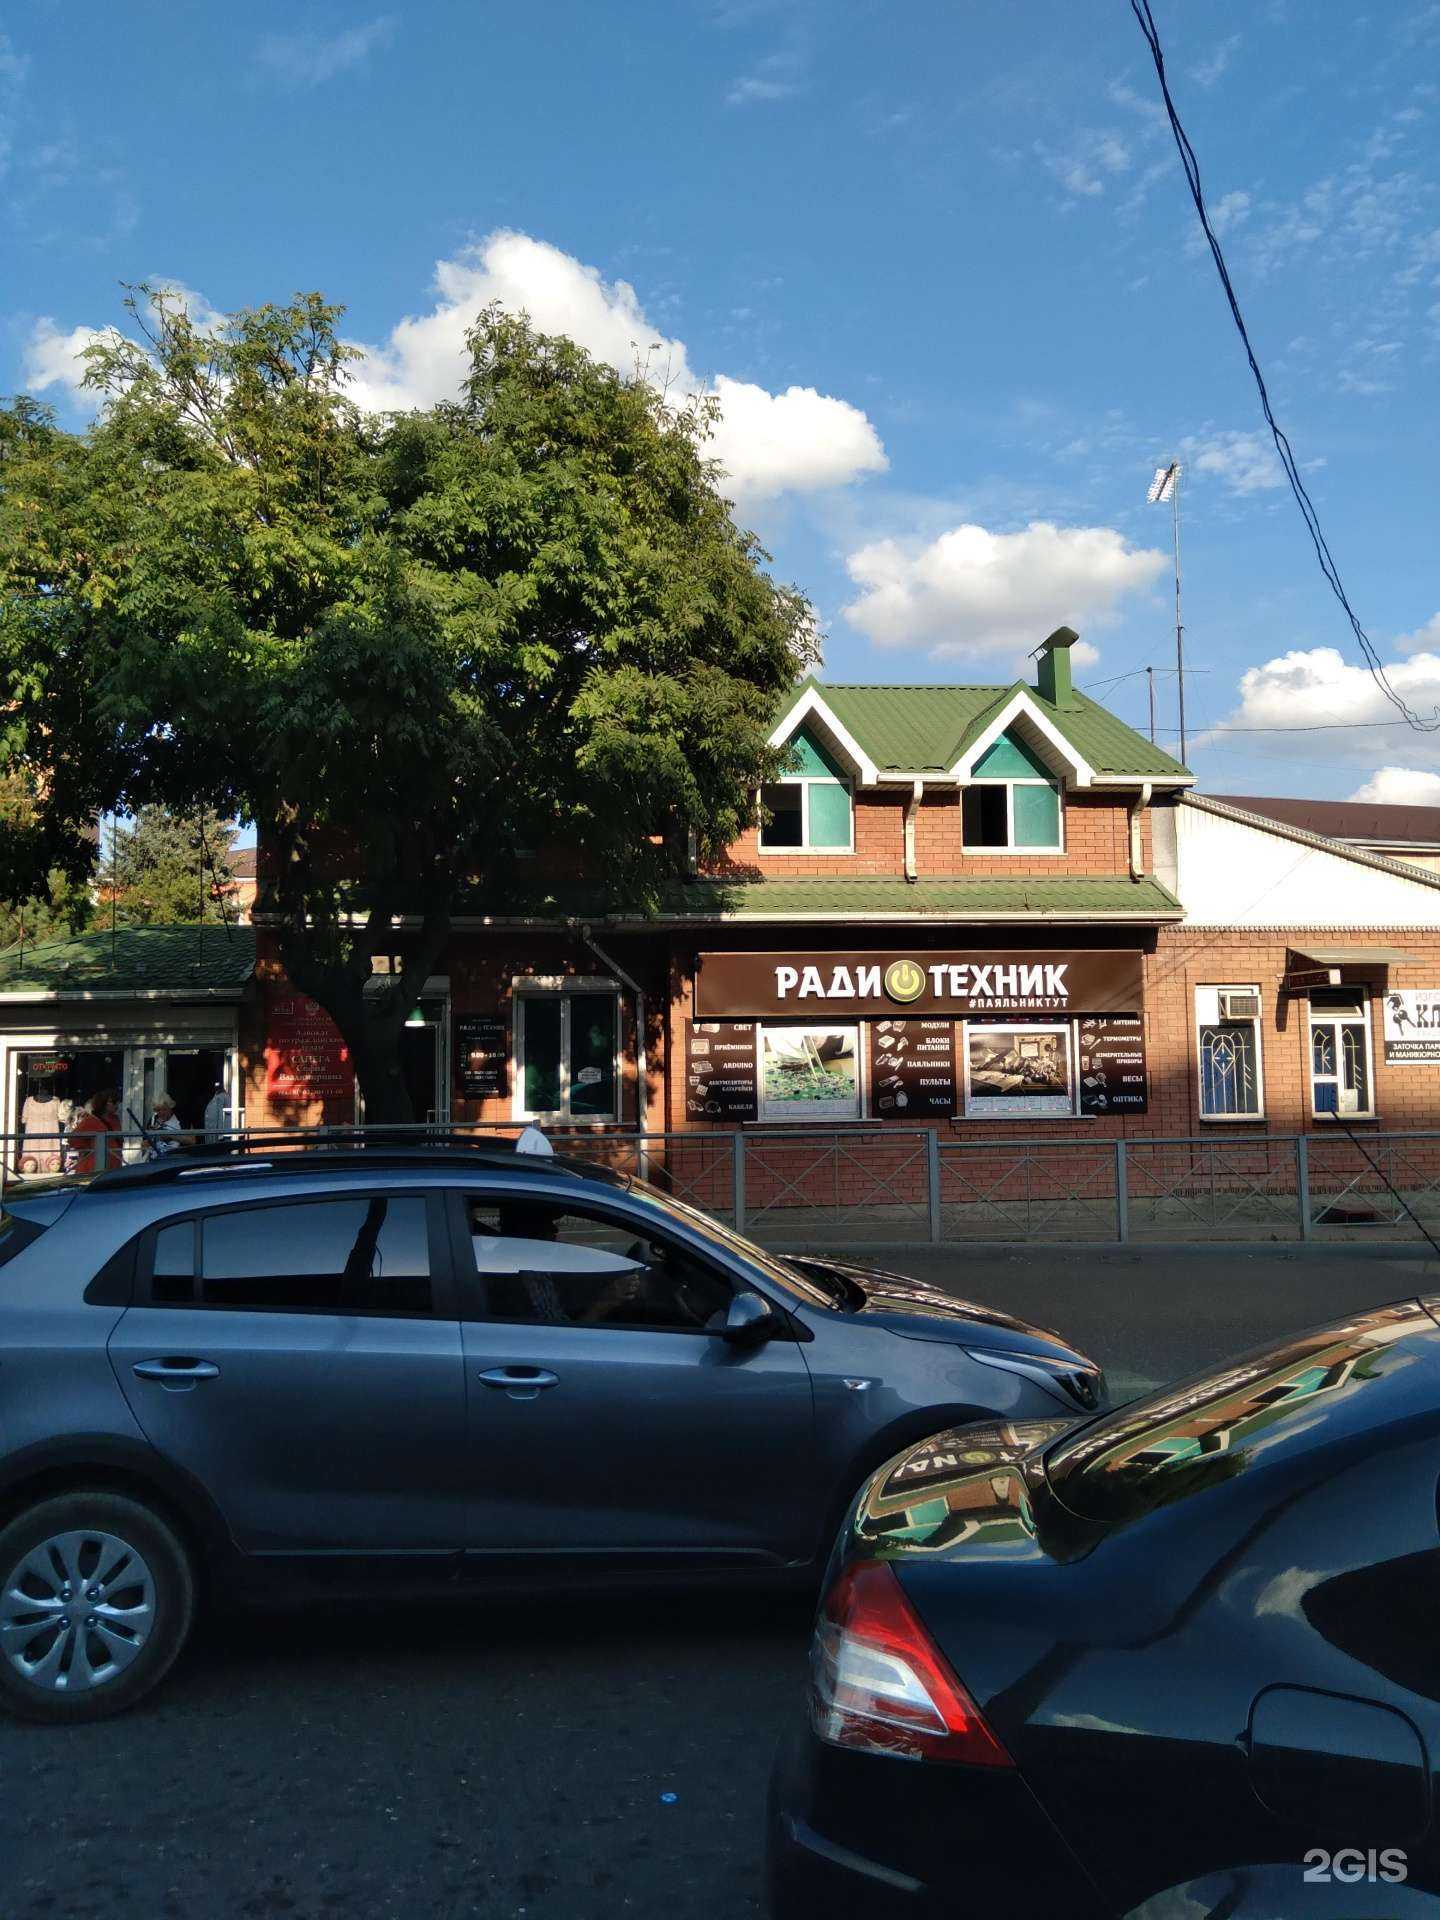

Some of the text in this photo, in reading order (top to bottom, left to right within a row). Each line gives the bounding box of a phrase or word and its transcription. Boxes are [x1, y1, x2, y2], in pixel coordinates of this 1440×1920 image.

[969, 998, 1068, 1008] #ПАЯЛЬНИКТУТ
[733, 1023, 753, 1031] СВЕТ
[919, 1078, 951, 1086] ПУЛЬТЫ
[1112, 1096, 1144, 1104] ОПТИКА
